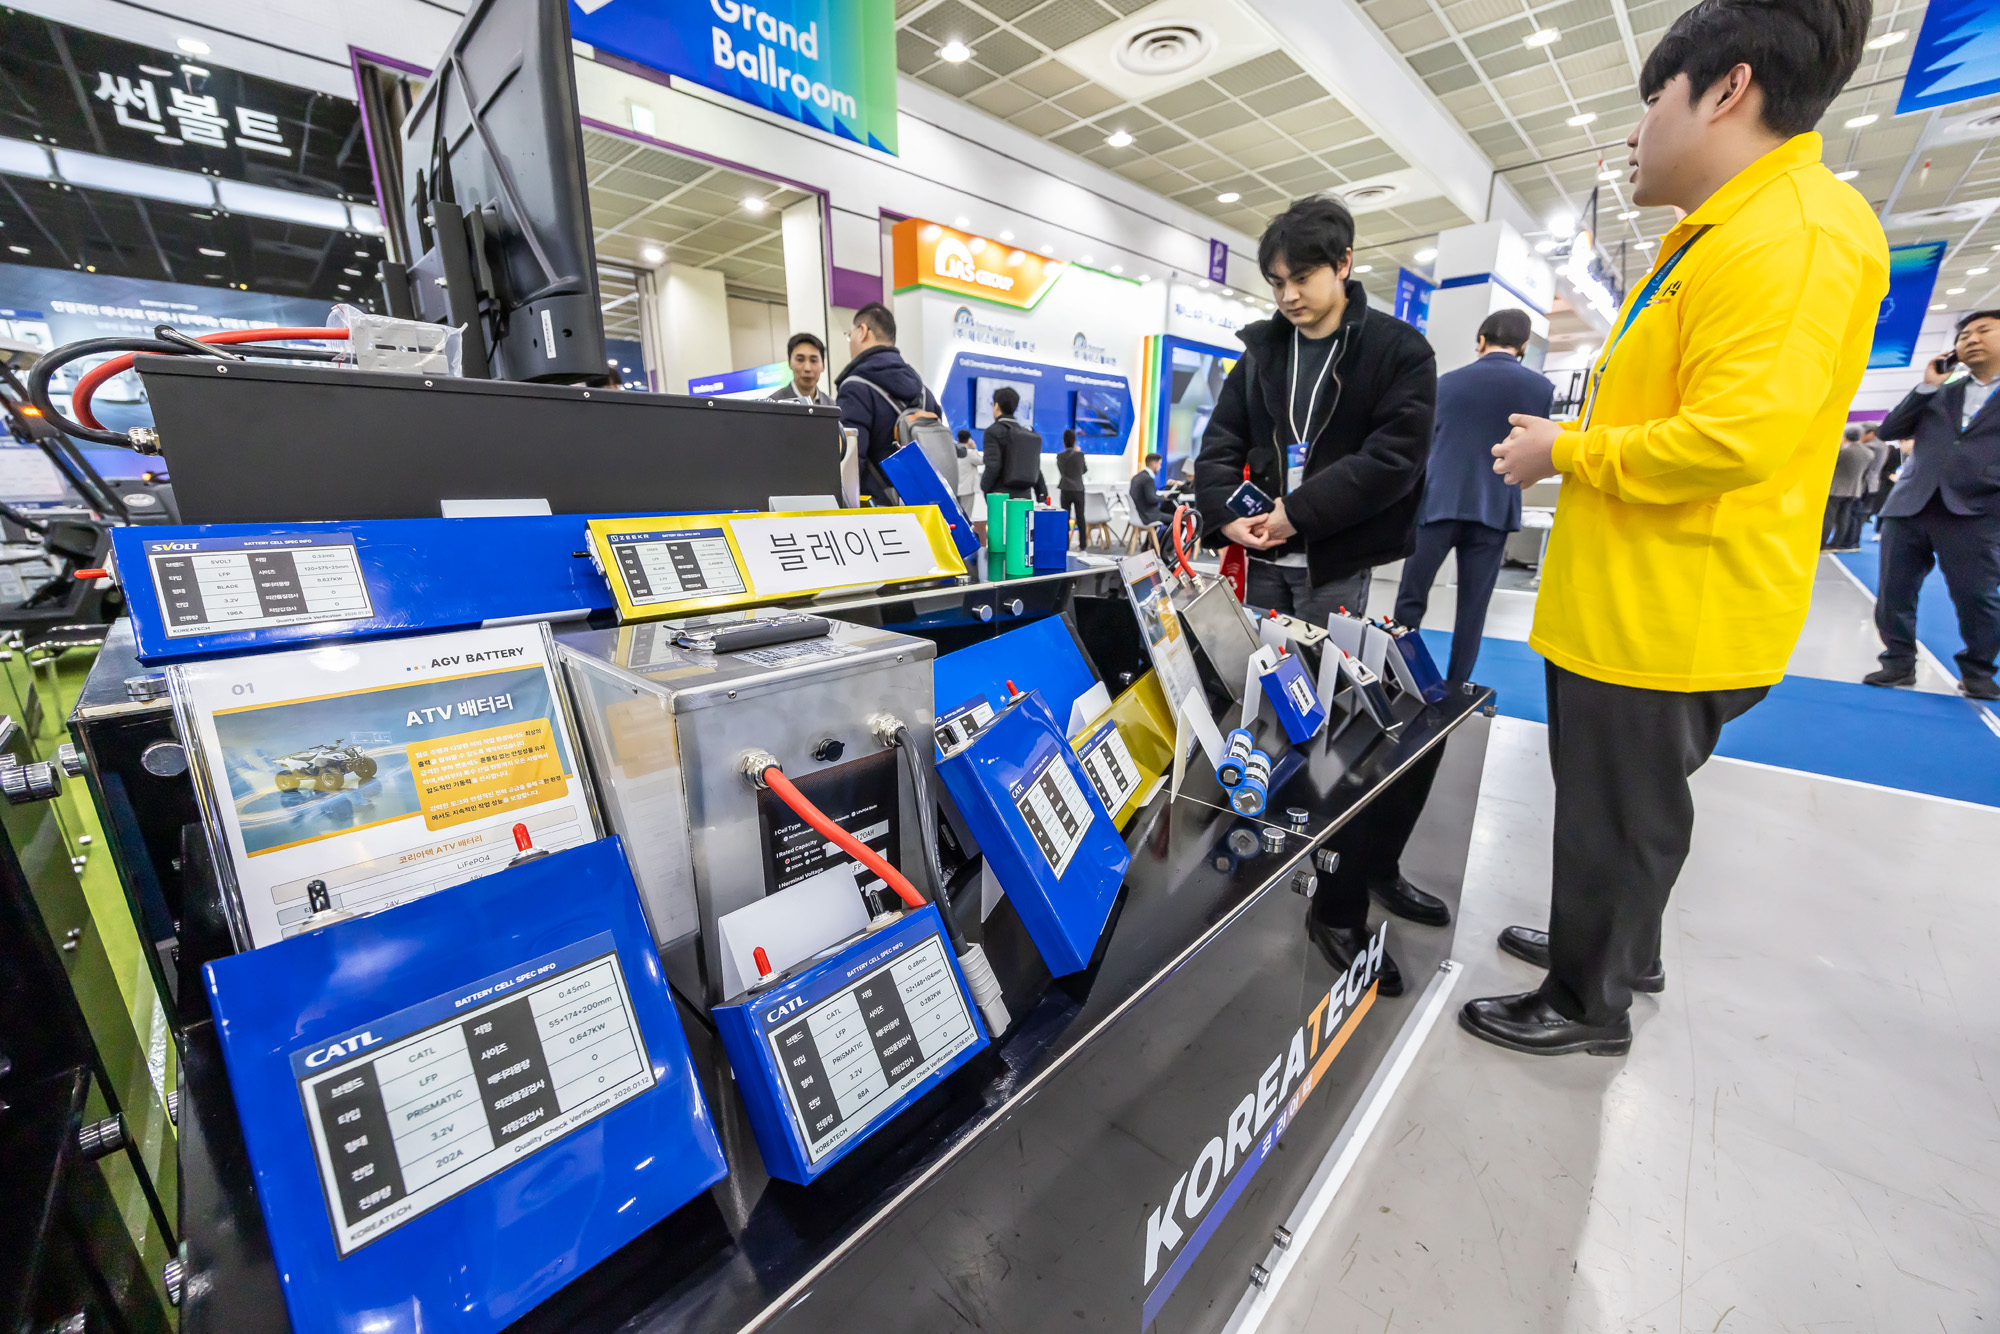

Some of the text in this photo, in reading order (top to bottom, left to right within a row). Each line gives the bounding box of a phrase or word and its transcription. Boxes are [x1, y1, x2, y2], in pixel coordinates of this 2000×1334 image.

[711, 26, 857, 119] Ballroom
[94, 71, 292, 157] 썬볼트
[152, 542, 199, 551] SVOLT
[770, 528, 911, 572] 블레이드
[430, 647, 525, 669] AGV BATTERY
[230, 682, 255, 696] 01
[406, 692, 514, 727] ATV 배터리
[1011, 783, 1025, 799] CATL
[777, 827, 788, 835] Cell
[788, 822, 801, 831] Type
[399, 834, 483, 865] 코리아텍 ATV 배터리
[456, 854, 491, 870] LiFePO4
[779, 840, 817, 857] Rated Capacity
[847, 942, 903, 977] BATTERY CELL SPEC INFO
[455, 963, 556, 1007] BATTERY CELL SPEC INFO
[474, 981, 590, 1035] 저항 0.45mΩ
[767, 996, 808, 1023] CATL
[826, 1009, 841, 1020] CATL
[305, 1031, 383, 1067] CATL
[835, 1028, 846, 1039] LFP
[481, 1043, 508, 1060] 사이즈
[487, 1023, 605, 1084] 배터리용량 0.647KW
[832, 1041, 863, 1065] PRISMATIC
[331, 1048, 436, 1098] 브랜드 CATL
[850, 1067, 862, 1080] 3.2V
[900, 1077, 916, 1090] Quality
[916, 1067, 930, 1079] Check
[930, 1049, 953, 1068] Verification
[338, 1073, 438, 1124] 타입 LFP
[406, 1090, 463, 1121] PRISMATIC
[1143, 920, 1389, 1287] KOREATECH
[514, 1077, 649, 1153] Quality Check Verification 2026.01.12
[1261, 1073, 1313, 1159] 코리아텍
[431, 1124, 454, 1141] 3.2V
[815, 1127, 848, 1154] KOREATECH
[436, 1149, 463, 1168] 202A
[350, 1204, 412, 1241] KOREATECH
